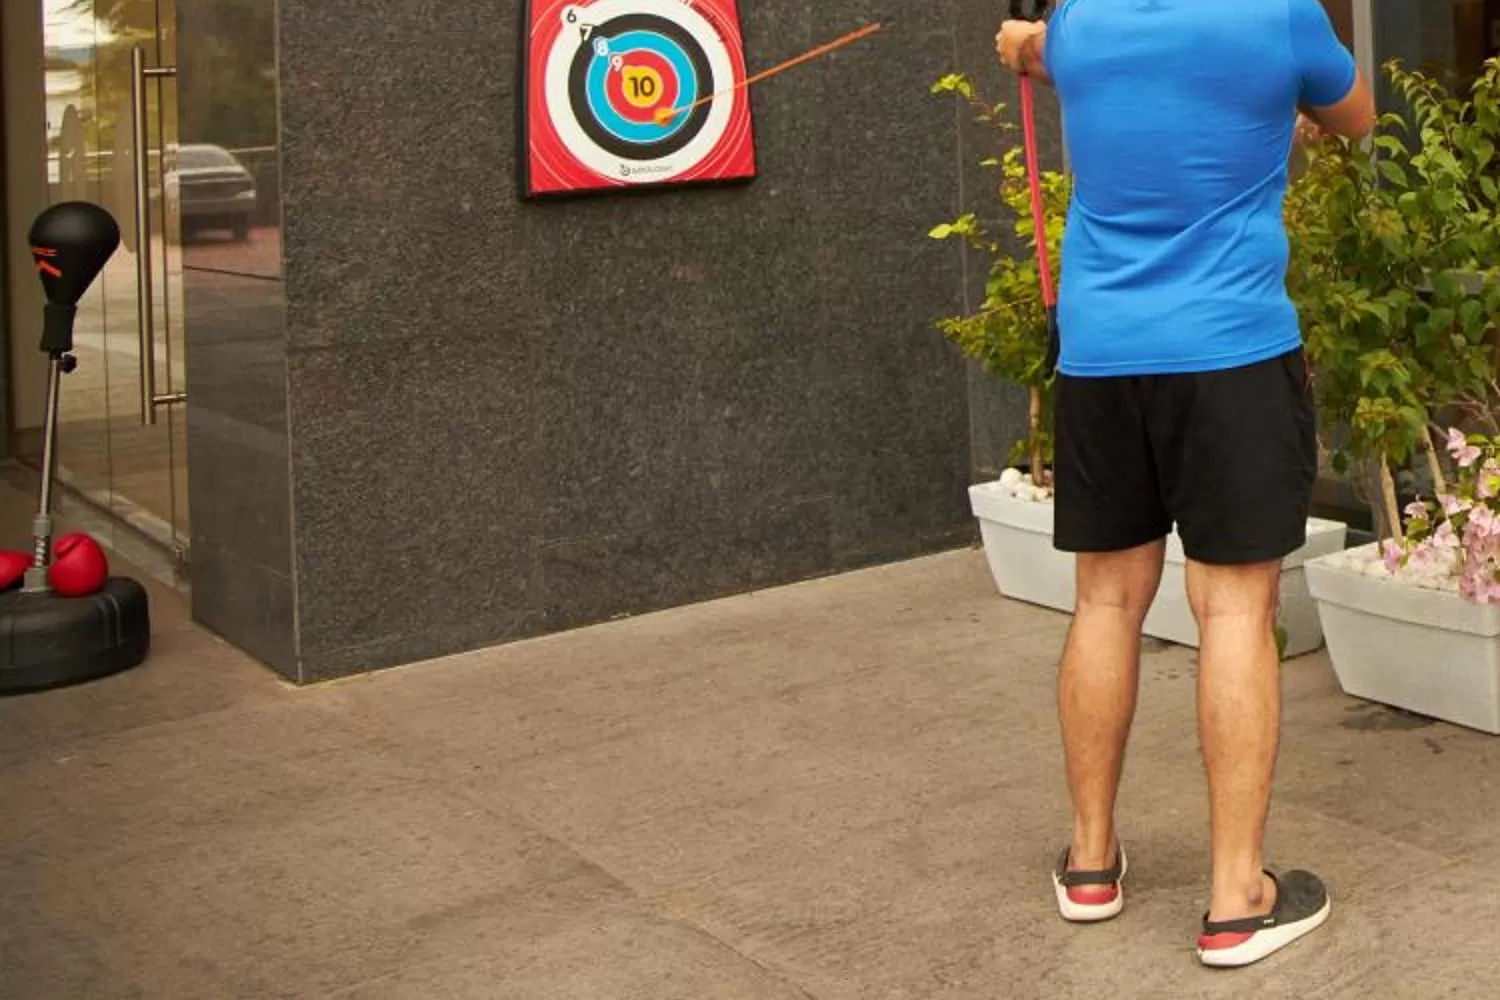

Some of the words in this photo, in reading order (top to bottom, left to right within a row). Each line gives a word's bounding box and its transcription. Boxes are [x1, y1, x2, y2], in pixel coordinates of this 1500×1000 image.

[566, 8, 577, 23] 6
[580, 24, 593, 41] 7
[611, 55, 623, 72] 9
[628, 75, 655, 97] 10
